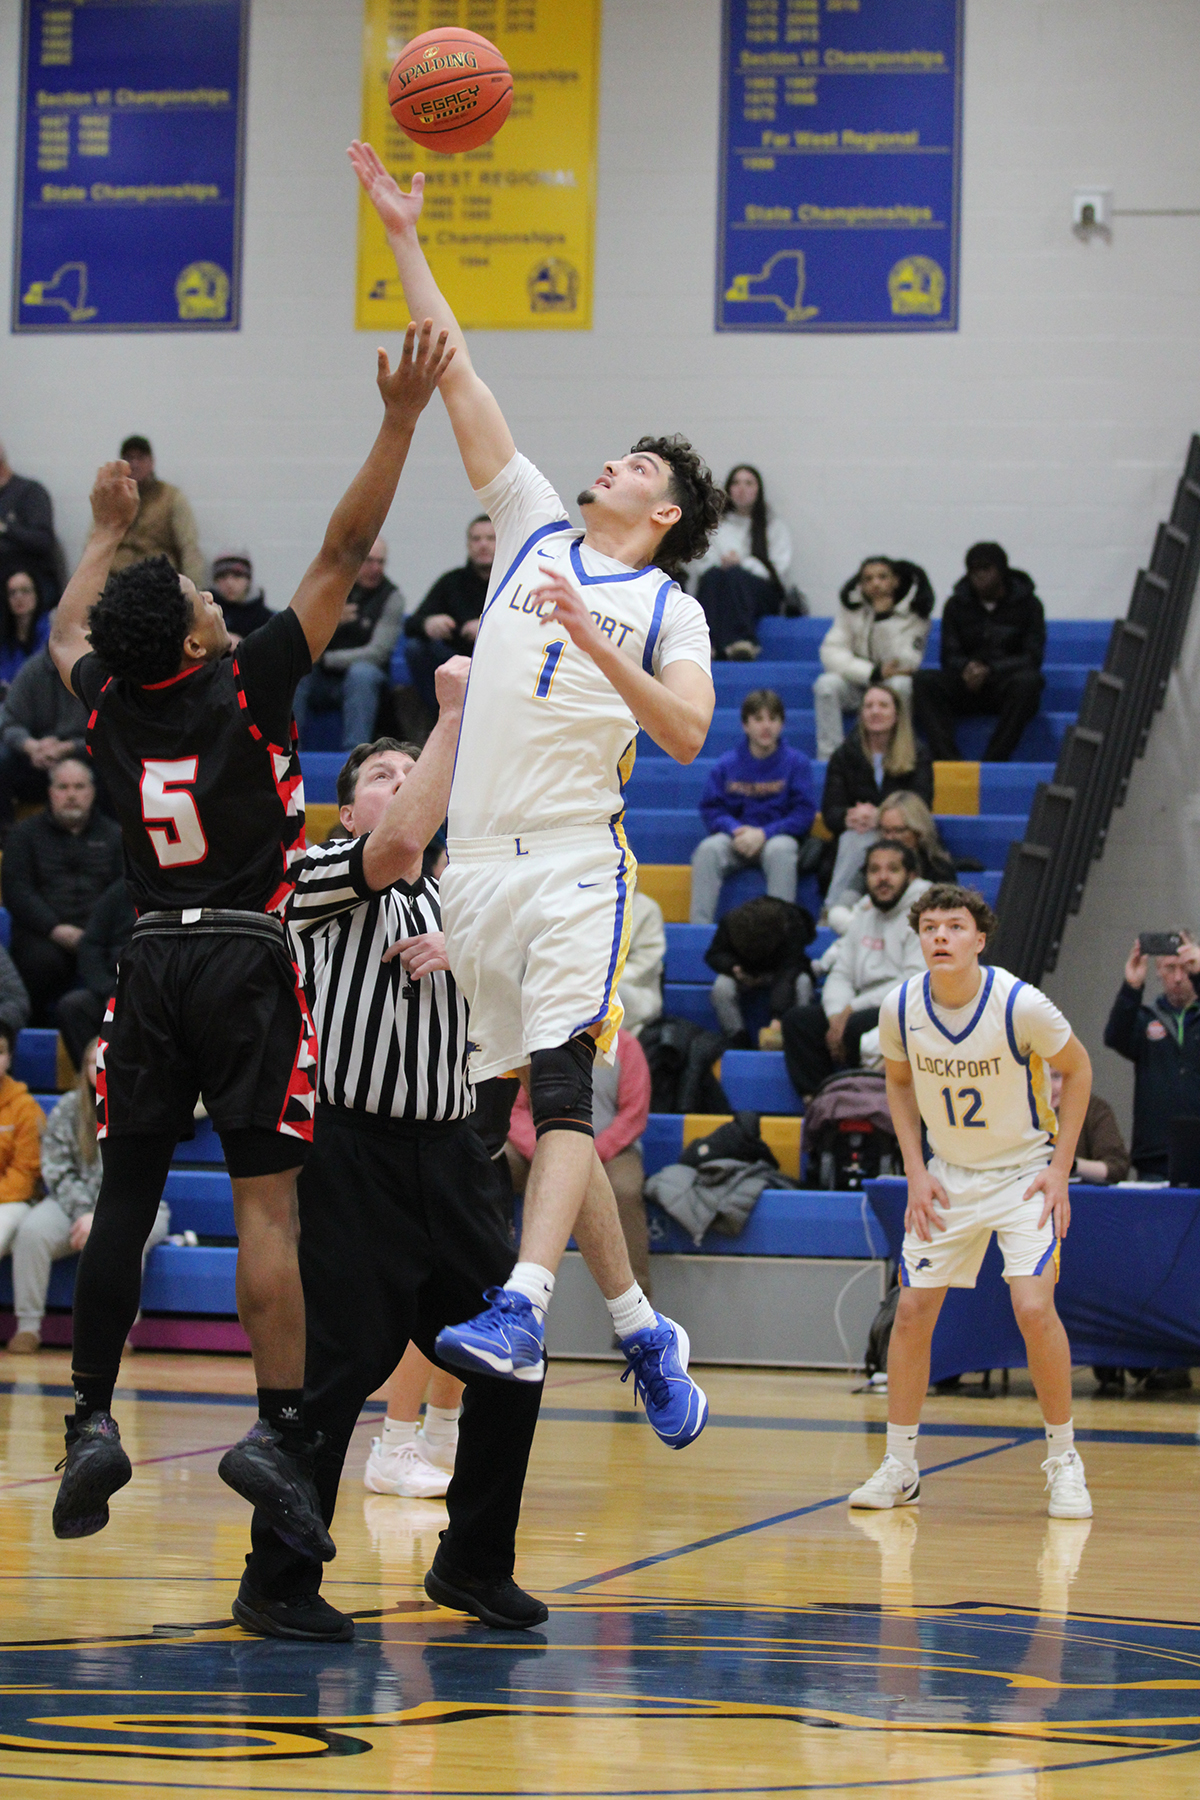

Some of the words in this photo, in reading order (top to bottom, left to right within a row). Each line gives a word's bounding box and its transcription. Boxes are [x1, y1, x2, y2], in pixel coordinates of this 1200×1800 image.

[824, 50, 944, 69] Championships
[398, 51, 478, 90] SPALDING
[115, 88, 230, 106] Championships
[411, 84, 480, 116] LEGACY
[436, 100, 478, 120] 1000
[796, 132, 838, 147] West
[842, 131, 919, 151] Regional
[91, 183, 218, 202] Championships
[746, 206, 791, 221] State
[798, 205, 931, 225] Championships
[532, 638, 569, 702] 1
[139, 755, 209, 869] 5
[513, 837, 530, 857] L
[916, 1053, 1002, 1078] LOCKPORT
[940, 1085, 988, 1130] 12
